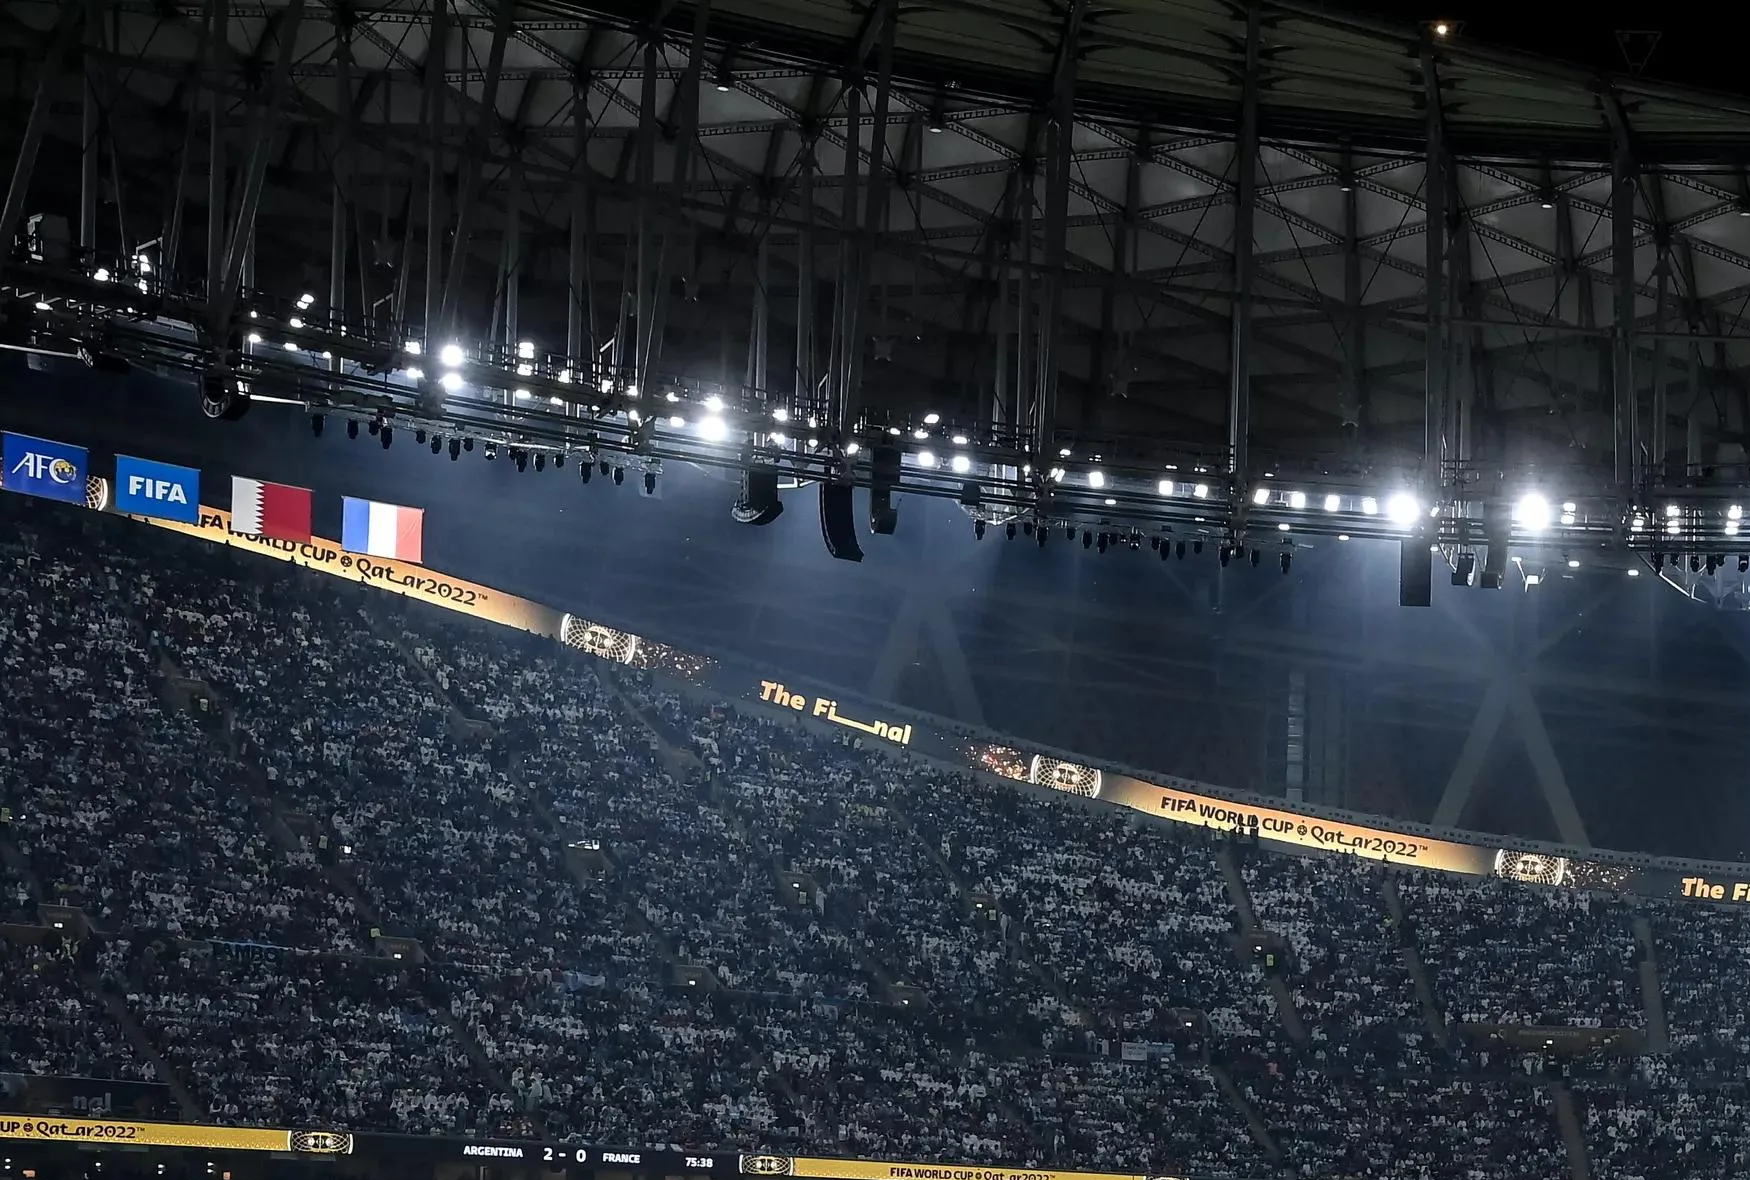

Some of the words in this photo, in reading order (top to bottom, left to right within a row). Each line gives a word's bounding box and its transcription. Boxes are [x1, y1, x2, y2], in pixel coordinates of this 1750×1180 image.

[12, 451, 77, 484] AFC
[129, 475, 188, 505] FIFA
[300, 543, 338, 564] CUP
[760, 680, 807, 711] The
[1161, 796, 1197, 813] FIFA
[1199, 805, 1259, 827] WORLD
[1261, 817, 1294, 834] CUP
[1680, 877, 1725, 900] The
[463, 1145, 524, 1158] ARGENTINA
[543, 1147, 553, 1161] 2
[575, 1148, 587, 1162] 0
[602, 1151, 641, 1164] FRANCE
[685, 1157, 714, 1169] 75:38
[890, 1167, 914, 1178] FIFA
[914, 1169, 951, 1180] WORLD
[953, 1171, 974, 1180] CUP
